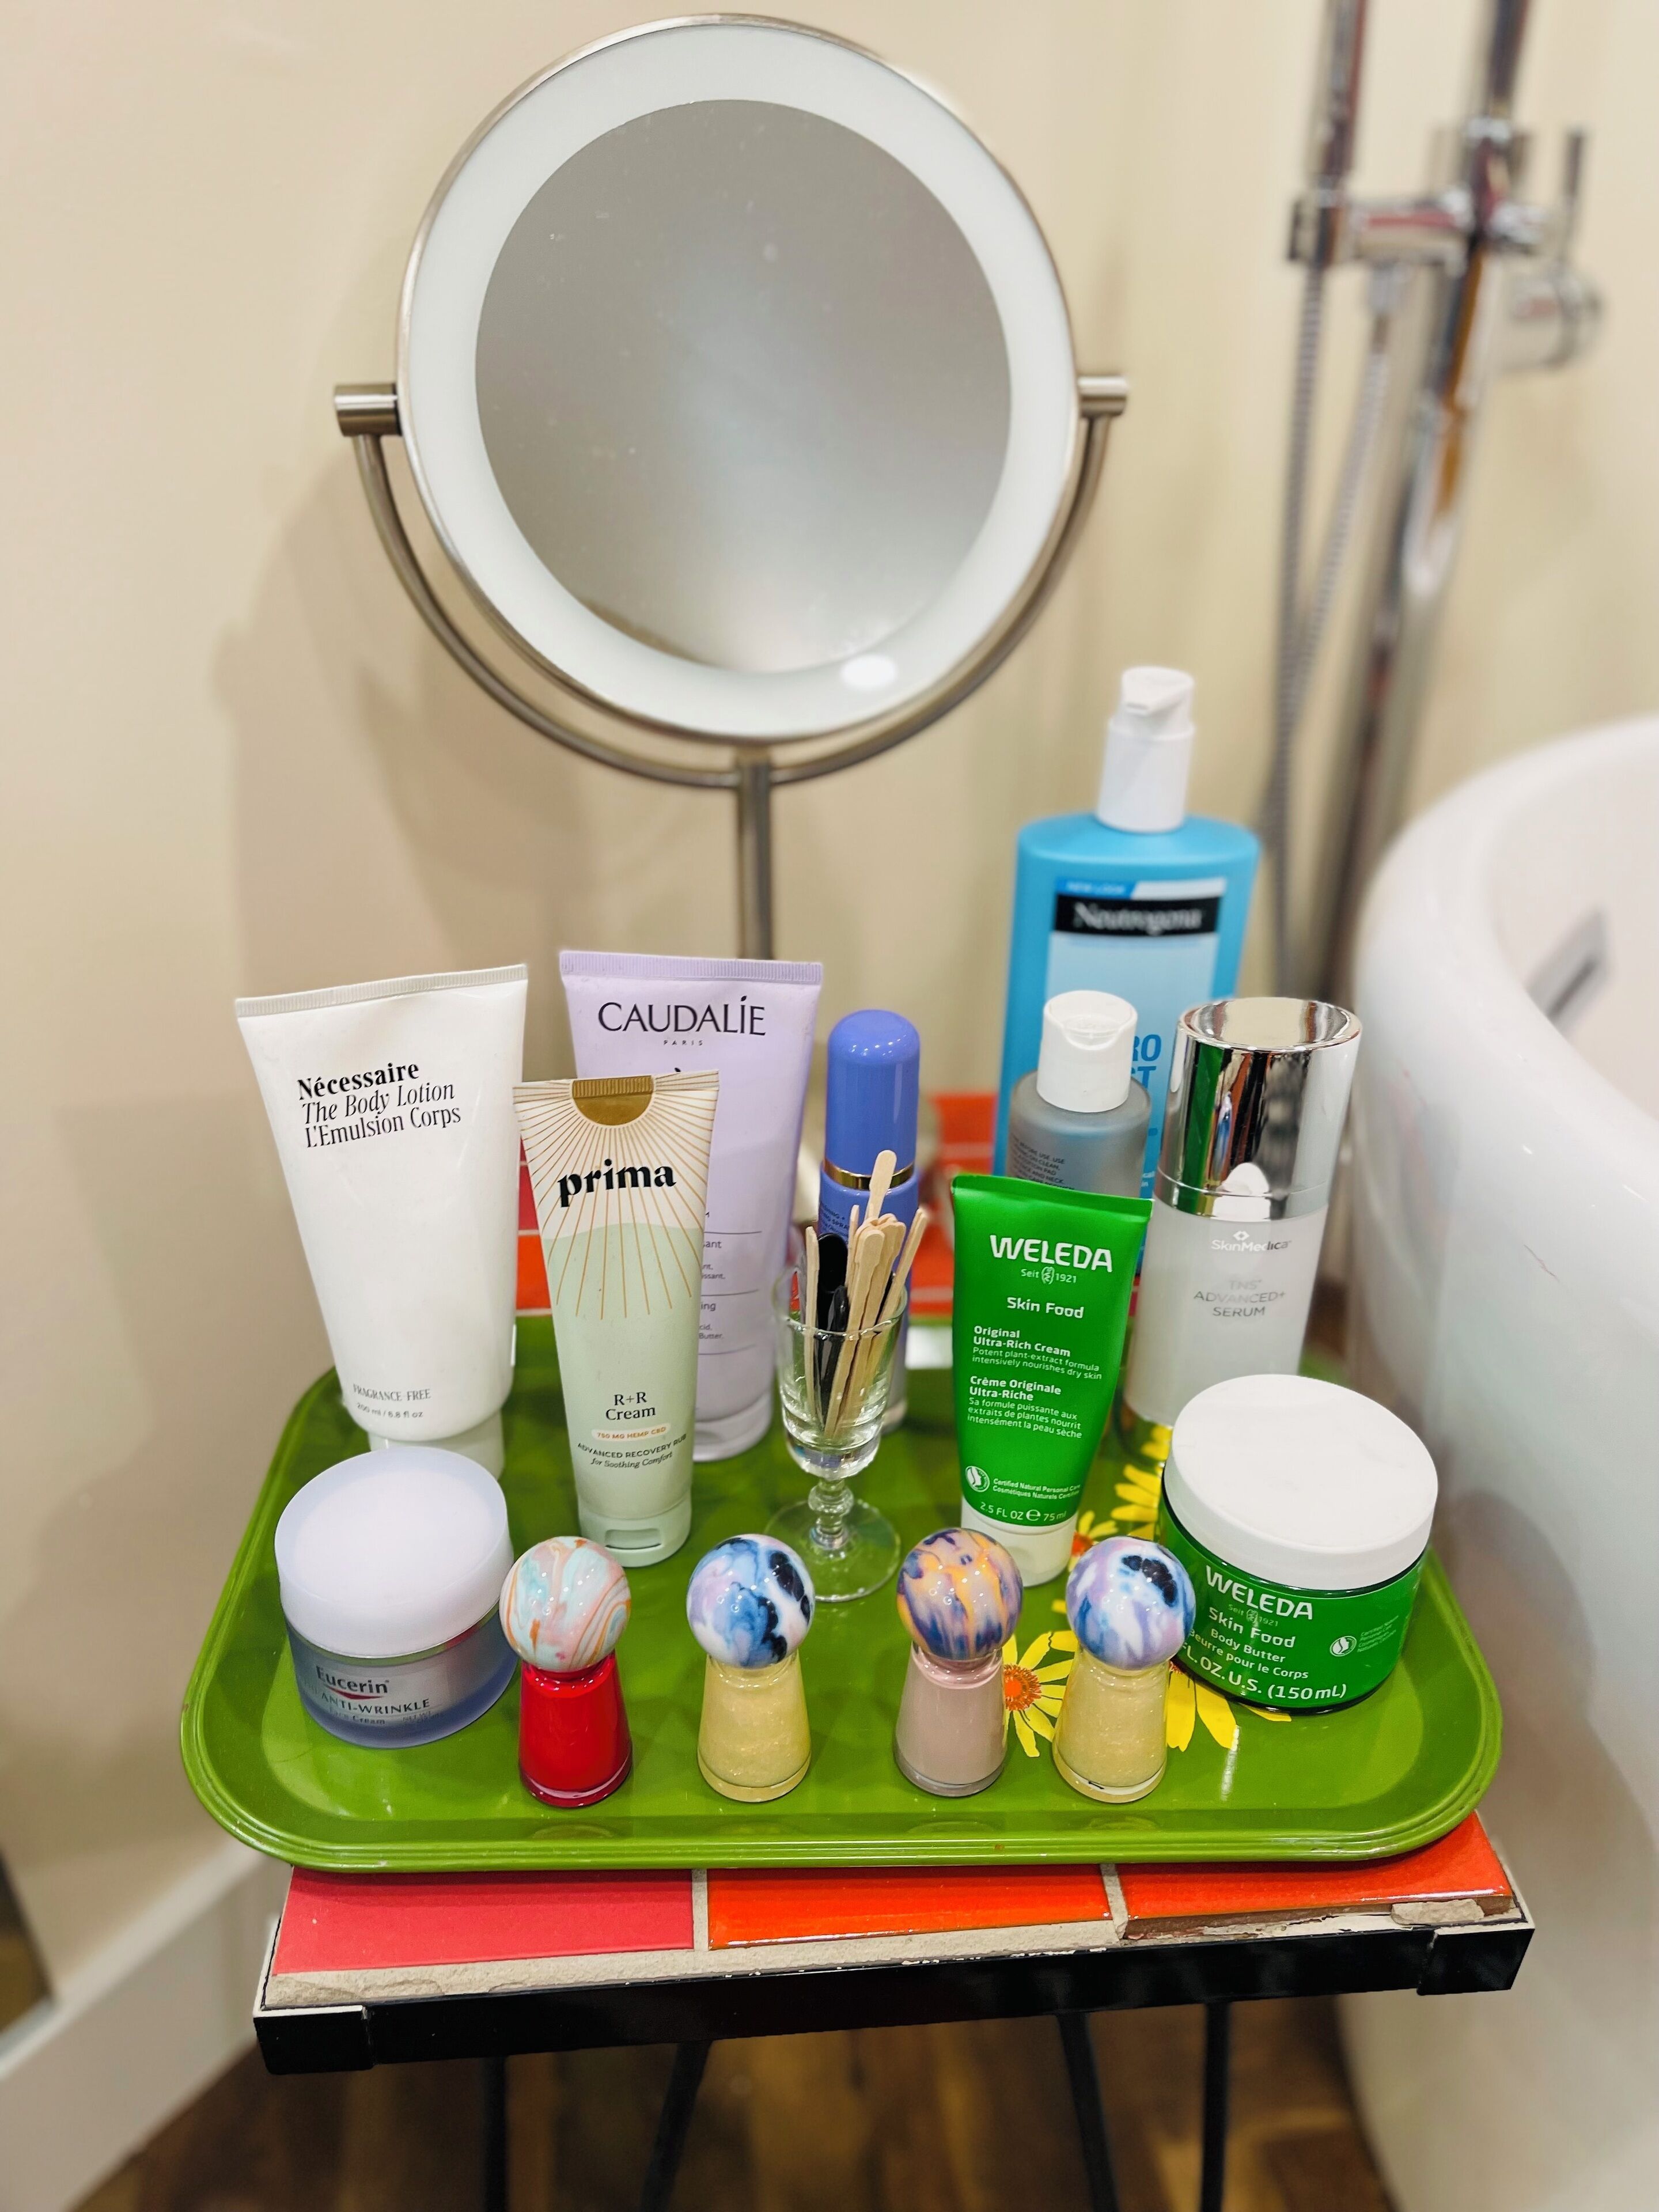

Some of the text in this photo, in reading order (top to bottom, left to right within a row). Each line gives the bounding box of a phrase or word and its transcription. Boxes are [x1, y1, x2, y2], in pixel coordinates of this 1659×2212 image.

[297, 1062, 419, 1100] Nécessaire
[301, 1082, 456, 1124] The Body Lotion
[305, 1107, 461, 1148] L'Emulsion Corps
[557, 1158, 677, 1208] prima
[990, 1234, 1112, 1272] WELEDA
[1021, 1268, 1077, 1283] Seit 1921
[1007, 1297, 1084, 1319] Skin Food
[1194, 1291, 1286, 1303] ADVANCED+
[1213, 1306, 1265, 1317] SERUM
[974, 1325, 1020, 1338] Original
[974, 1336, 1070, 1357] Ultra-Rich Cream
[972, 1355, 1102, 1380] intensively nourishes dry skin
[973, 1347, 1100, 1372] Potent plant-extract formula
[353, 1382, 431, 1402] FRAGRANCE FREE
[969, 1386, 1034, 1401] Ultra-Riche
[1009, 1379, 1061, 1395] Originale
[614, 1392, 647, 1406] R+R
[969, 1397, 1077, 1421] Sa formule puissante aux
[606, 1407, 656, 1421] Cream
[968, 1407, 1081, 1430] extraits de plantes nourrit
[651, 1427, 666, 1435] CBD
[967, 1414, 1082, 1438] intensément la peau sèche
[578, 1443, 623, 1459] ADVANCED
[625, 1442, 672, 1458] RECOVERY
[604, 1460, 640, 1469] Soothing
[642, 1451, 673, 1467] Comfort
[993, 1478, 1019, 1488] Certified
[1020, 1482, 1041, 1492] Natural
[980, 1502, 994, 1513] 2.5
[996, 1508, 1007, 1518] FL
[1010, 1510, 1024, 1520] OZ
[1206, 1565, 1313, 1620] WELEDA
[1209, 1607, 1296, 1648] Skin Food
[1211, 1628, 1286, 1662] Body Butter
[1226, 1653, 1255, 1669] pour
[1258, 1662, 1269, 1673] le
[1272, 1667, 1309, 1680] Corps
[316, 1665, 388, 1694] Eucerin
[322, 1692, 430, 1715] ANTI-WRINKLE
